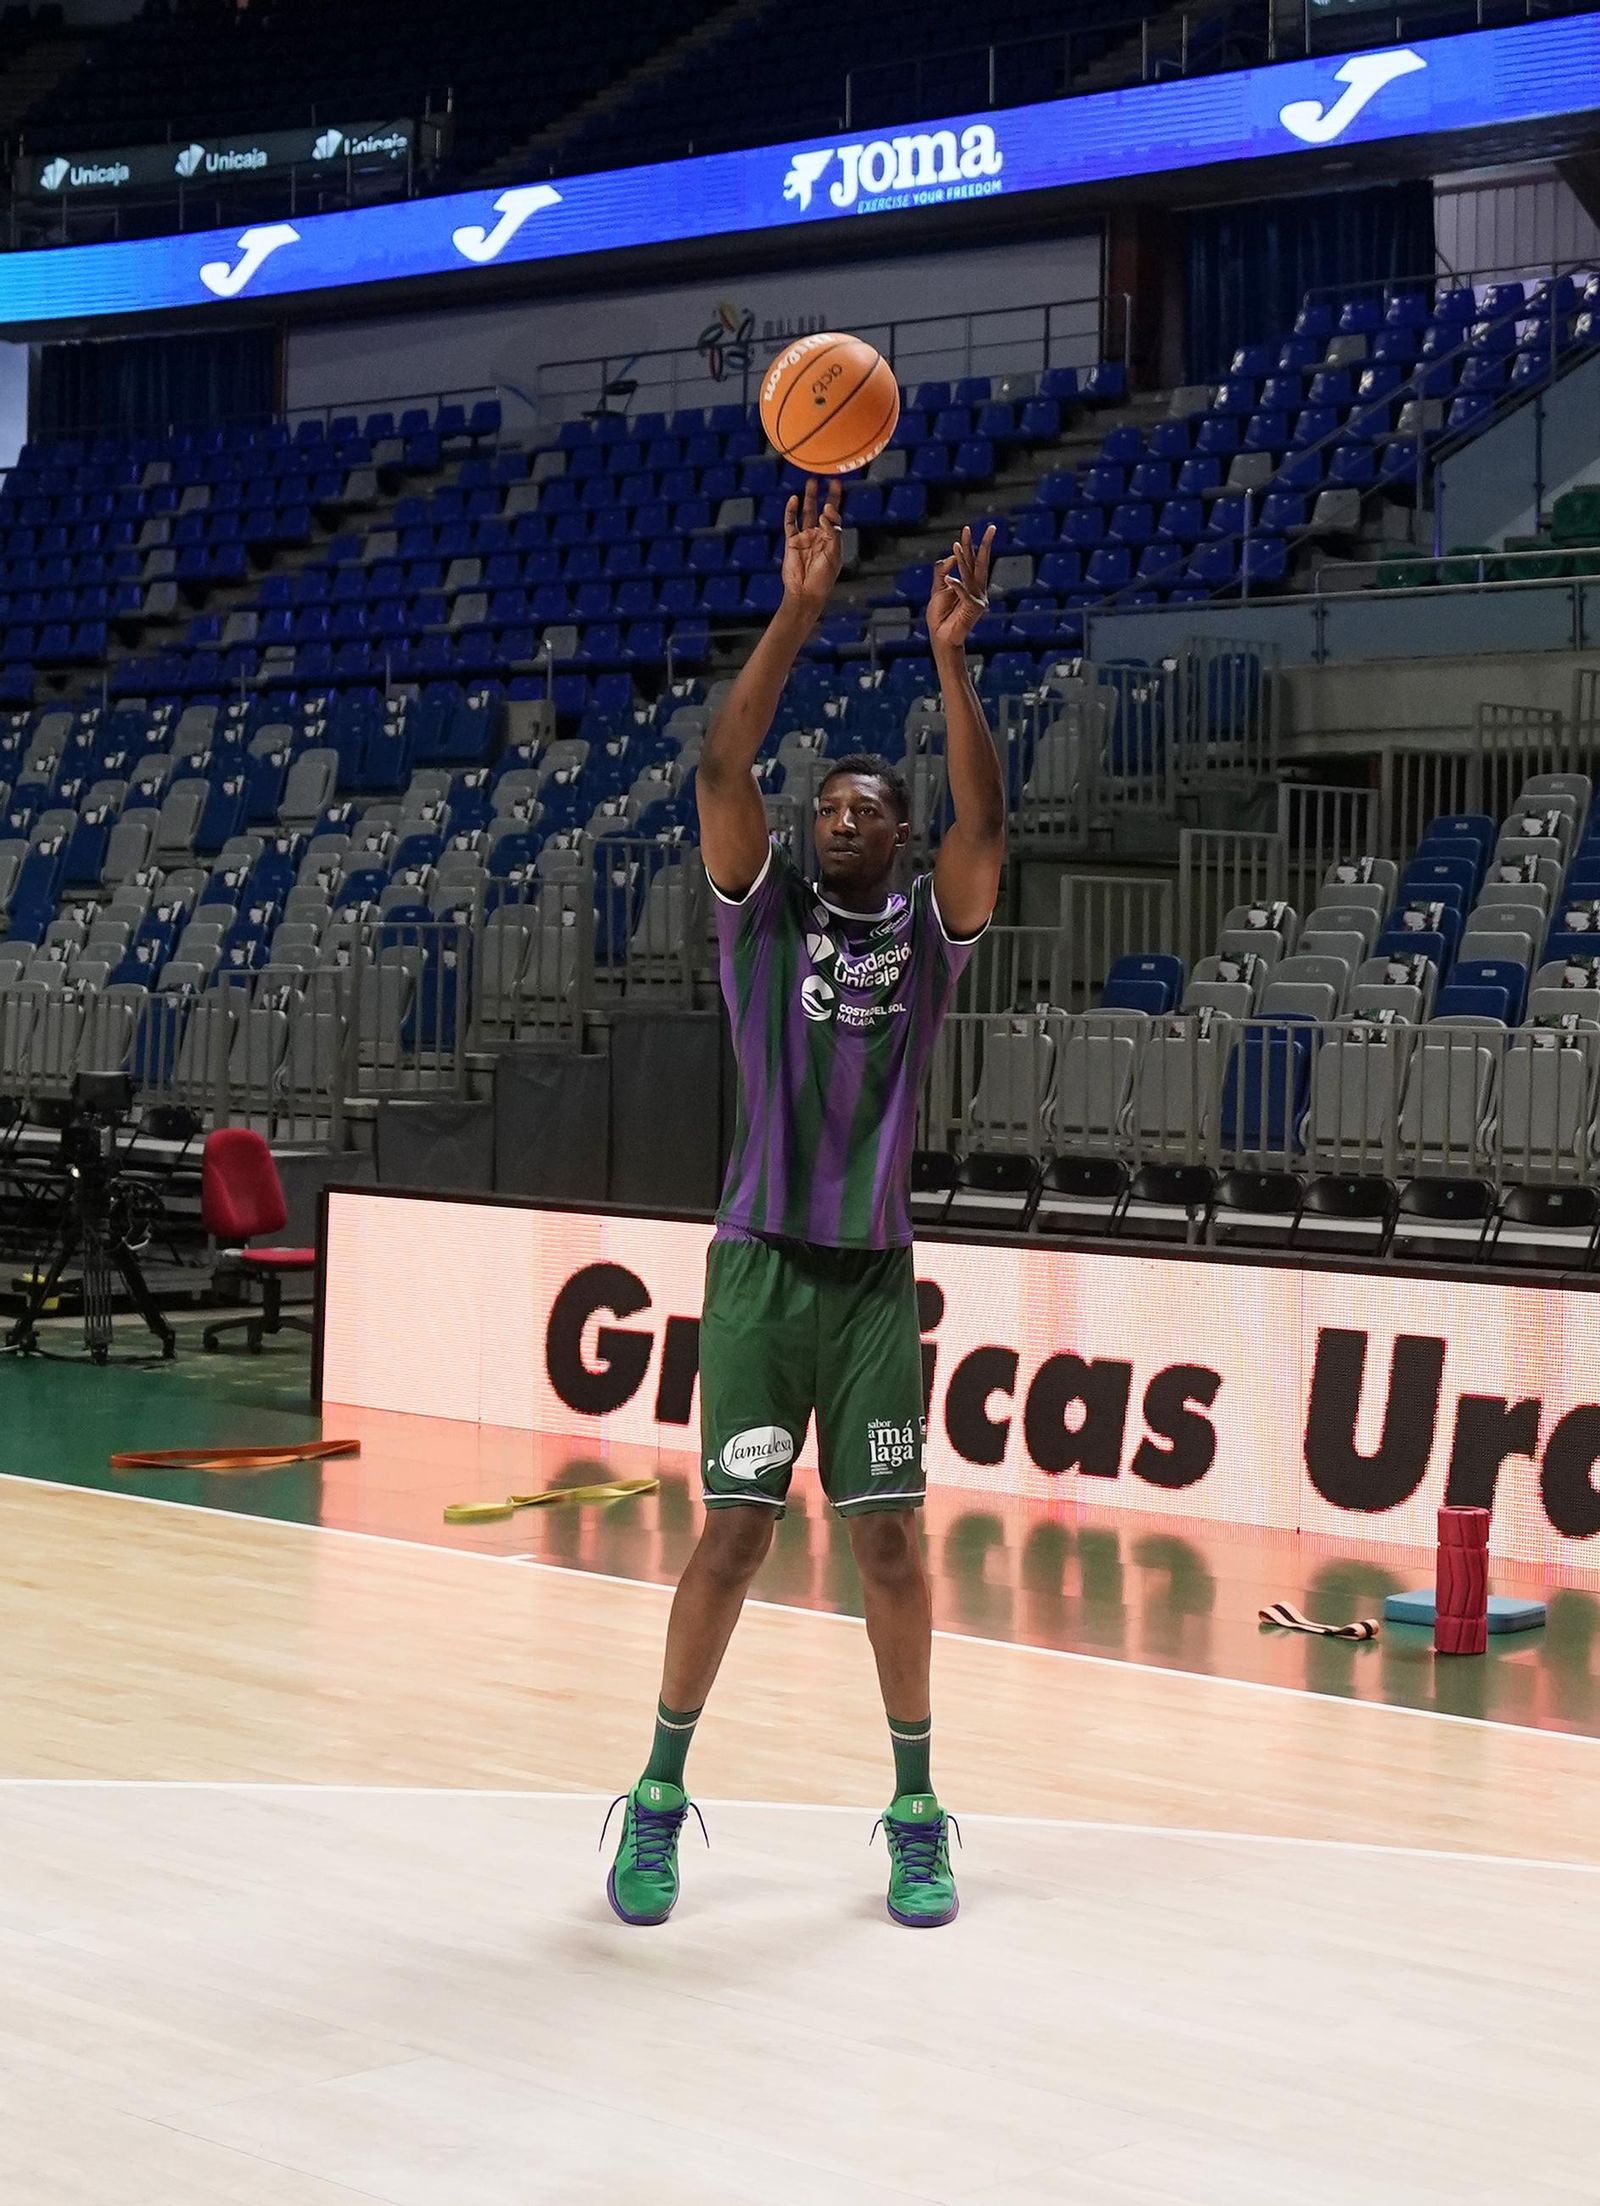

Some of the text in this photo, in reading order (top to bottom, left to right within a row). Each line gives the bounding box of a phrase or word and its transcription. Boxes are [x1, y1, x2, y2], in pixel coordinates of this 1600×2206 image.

[205, 148, 268, 172] Unicaja
[69, 161, 130, 186] Unicaja
[857, 179, 1002, 215] EXERCISE YOUR FREEDOM
[833, 965, 900, 988] Unicaja
[888, 1003, 907, 1014] SOL
[867, 1418, 892, 1429] sabor
[875, 1419, 914, 1446] má
[869, 1440, 914, 1467] laga
